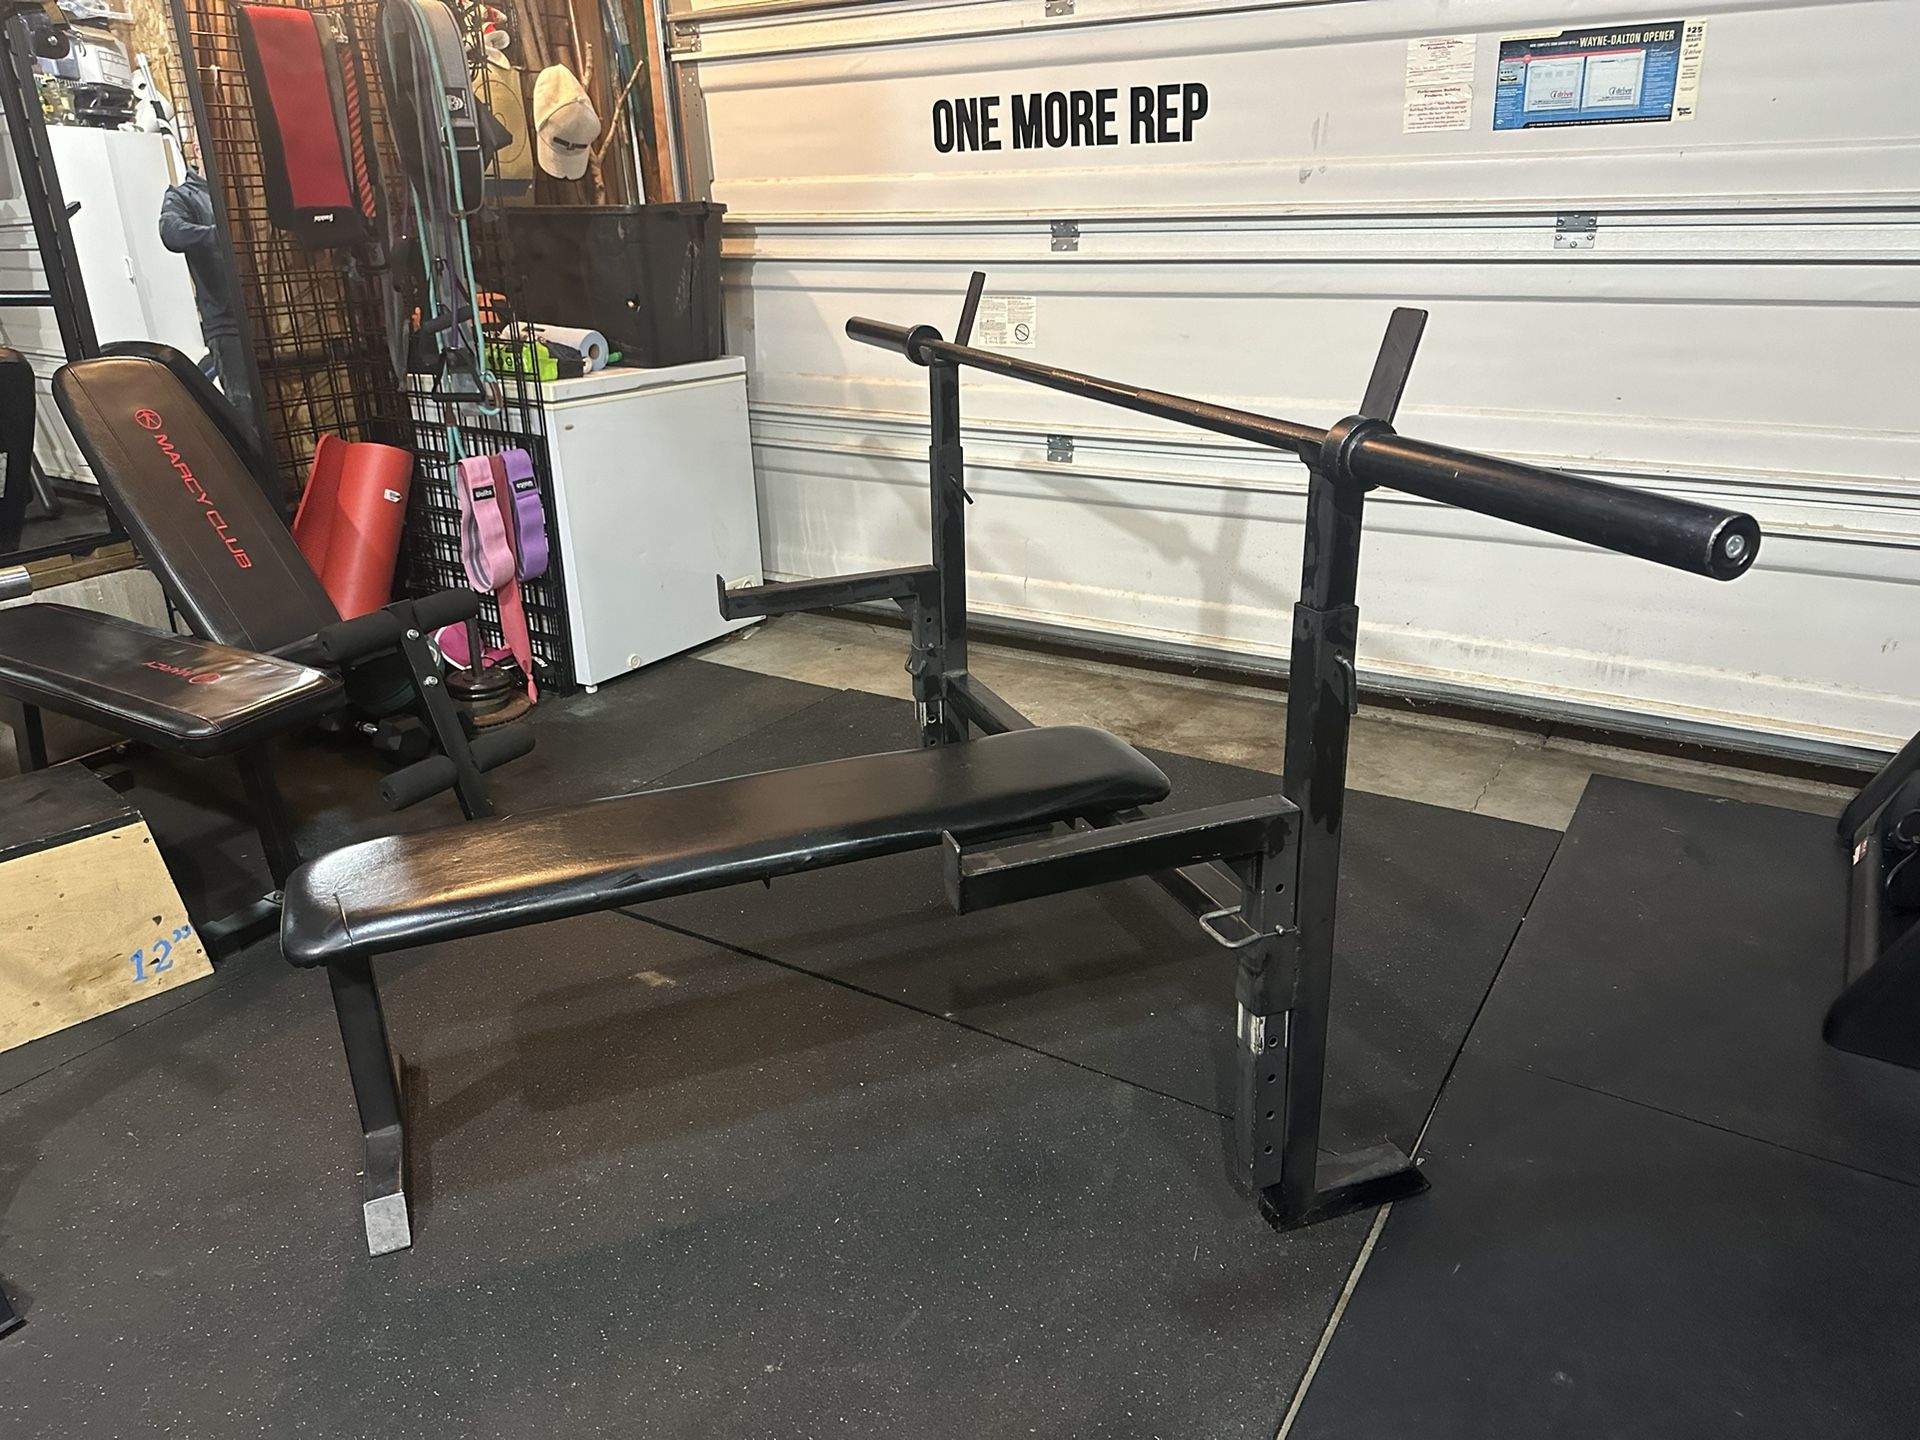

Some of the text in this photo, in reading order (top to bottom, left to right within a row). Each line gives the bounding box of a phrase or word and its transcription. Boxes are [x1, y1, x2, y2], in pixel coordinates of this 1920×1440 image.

[1579, 32, 1641, 48] WAYNE-DALTON
[1643, 30, 1675, 43] OPENER
[1687, 26, 1703, 34] $25
[932, 82, 1208, 153] ONE MORE REP
[153, 432, 252, 569] MARCY CLUB
